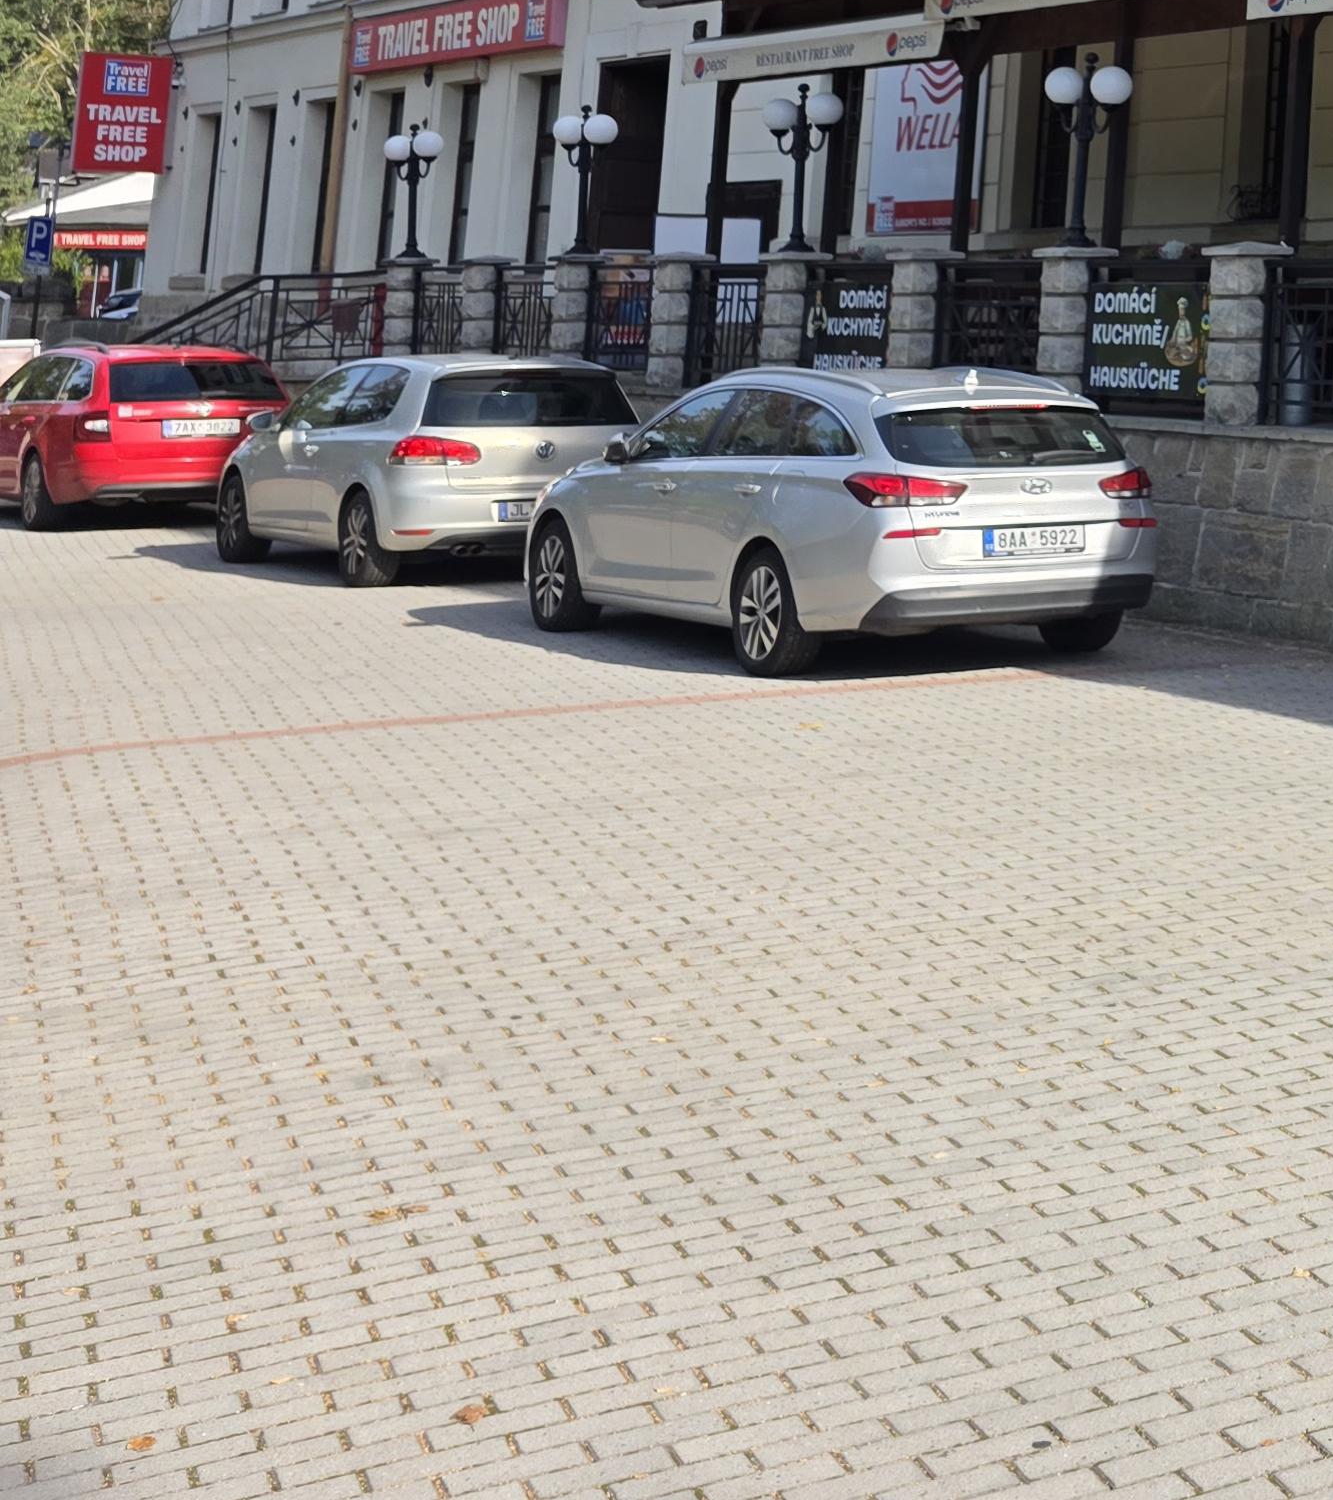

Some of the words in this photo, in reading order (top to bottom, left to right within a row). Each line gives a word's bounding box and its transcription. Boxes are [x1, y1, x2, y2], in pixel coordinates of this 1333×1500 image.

[377, 18, 429, 60] TRAVEL
[433, 11, 473, 51] FREE
[476, 4, 520, 46] SHOP
[526, 17, 545, 37] FREE
[756, 49, 808, 68] RESTAURANT
[809, 46, 829, 61] FREE
[831, 44, 855, 59] SHOP
[898, 32, 927, 52] pepsi
[108, 62, 148, 77] Travel
[107, 76, 147, 92] FREE
[87, 104, 161, 123] TRAVEL
[97, 125, 148, 143] FREE
[94, 144, 147, 162] SHOP
[31, 221, 48, 248] P
[61, 233, 94, 245] TRAVEL
[96, 233, 119, 245] FREE
[121, 233, 146, 245] SHOP
[839, 284, 888, 309] DOMÁCÍ
[1094, 286, 1157, 314] DOMÁCÍ
[1090, 361, 1180, 391] HAUSKÜCHE
[998, 531, 1028, 549] 8AA
[1039, 529, 1078, 546] 5922
